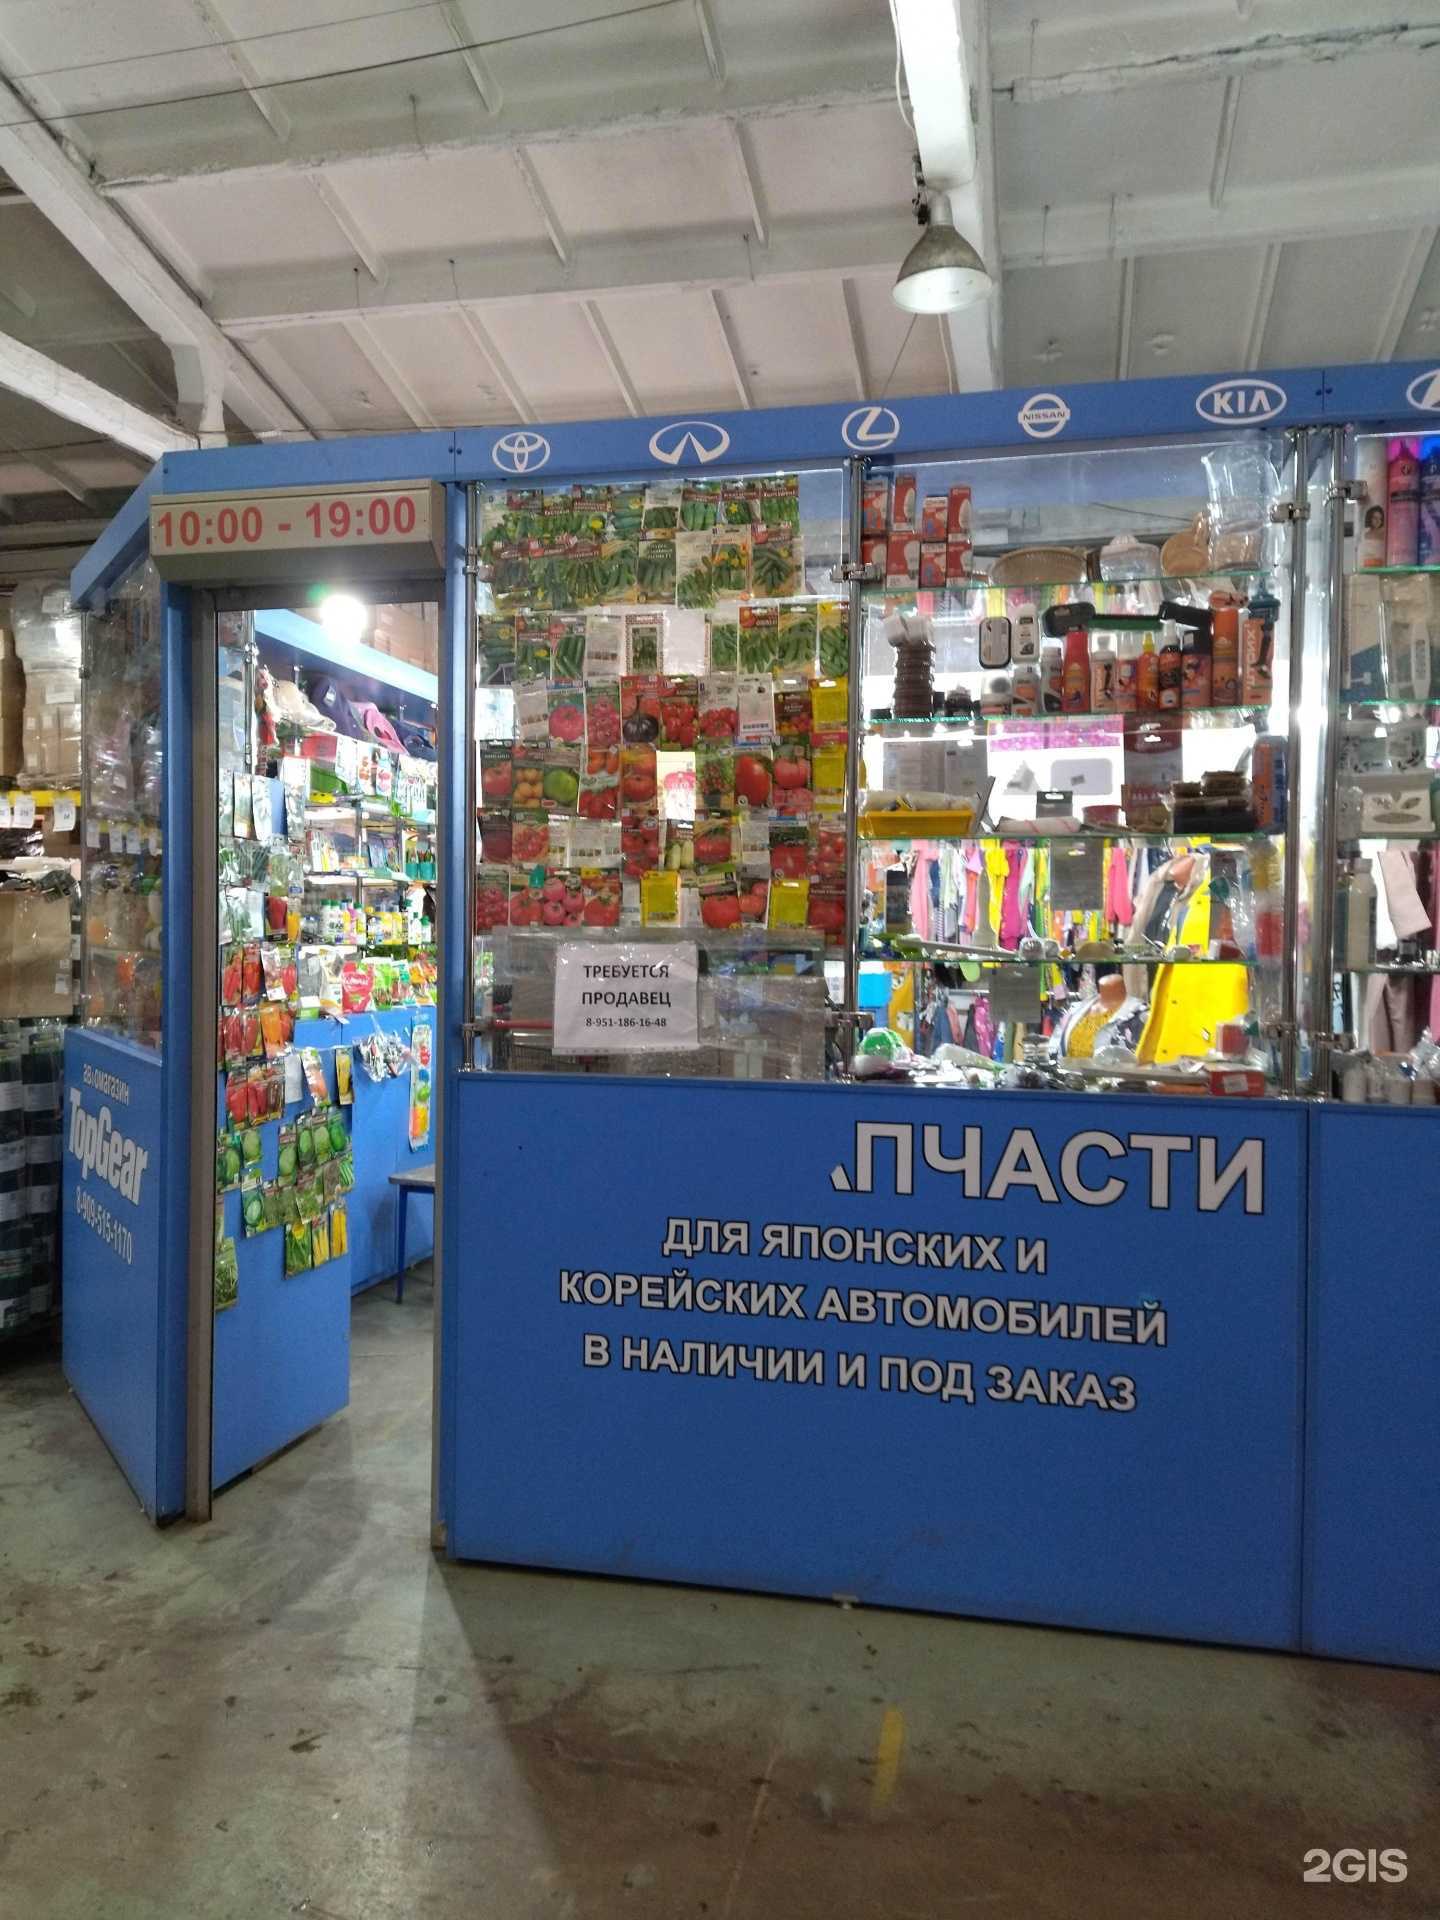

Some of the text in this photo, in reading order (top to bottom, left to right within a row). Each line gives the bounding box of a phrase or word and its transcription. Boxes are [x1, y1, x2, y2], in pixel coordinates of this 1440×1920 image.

[1022, 410, 1066, 421] NISSAN
[1213, 390, 1272, 416] KIA
[158, 505, 264, 548] 10:00
[305, 495, 417, 539] 19:00
[581, 991, 672, 1008] ПРОДАВЕЦ
[583, 965, 669, 979] ТРЕБУЕТСЯ
[585, 1017, 667, 1028] 8-951-186-16-48
[69, 1087, 149, 1206] TopGear
[829, 1120, 1265, 1215] ПЧАСТИ
[76, 1185, 133, 1265] 8-909-515-1170
[662, 1217, 1048, 1275] ДЛЯ ЯПОНСКИХ И
[559, 1267, 1168, 1347] КОРЕЙСКИХ АВТОМОБИЛЕЙ
[583, 1333, 1137, 1413] В НАЛИЧИИ И ПОД ЗАКАЗ
